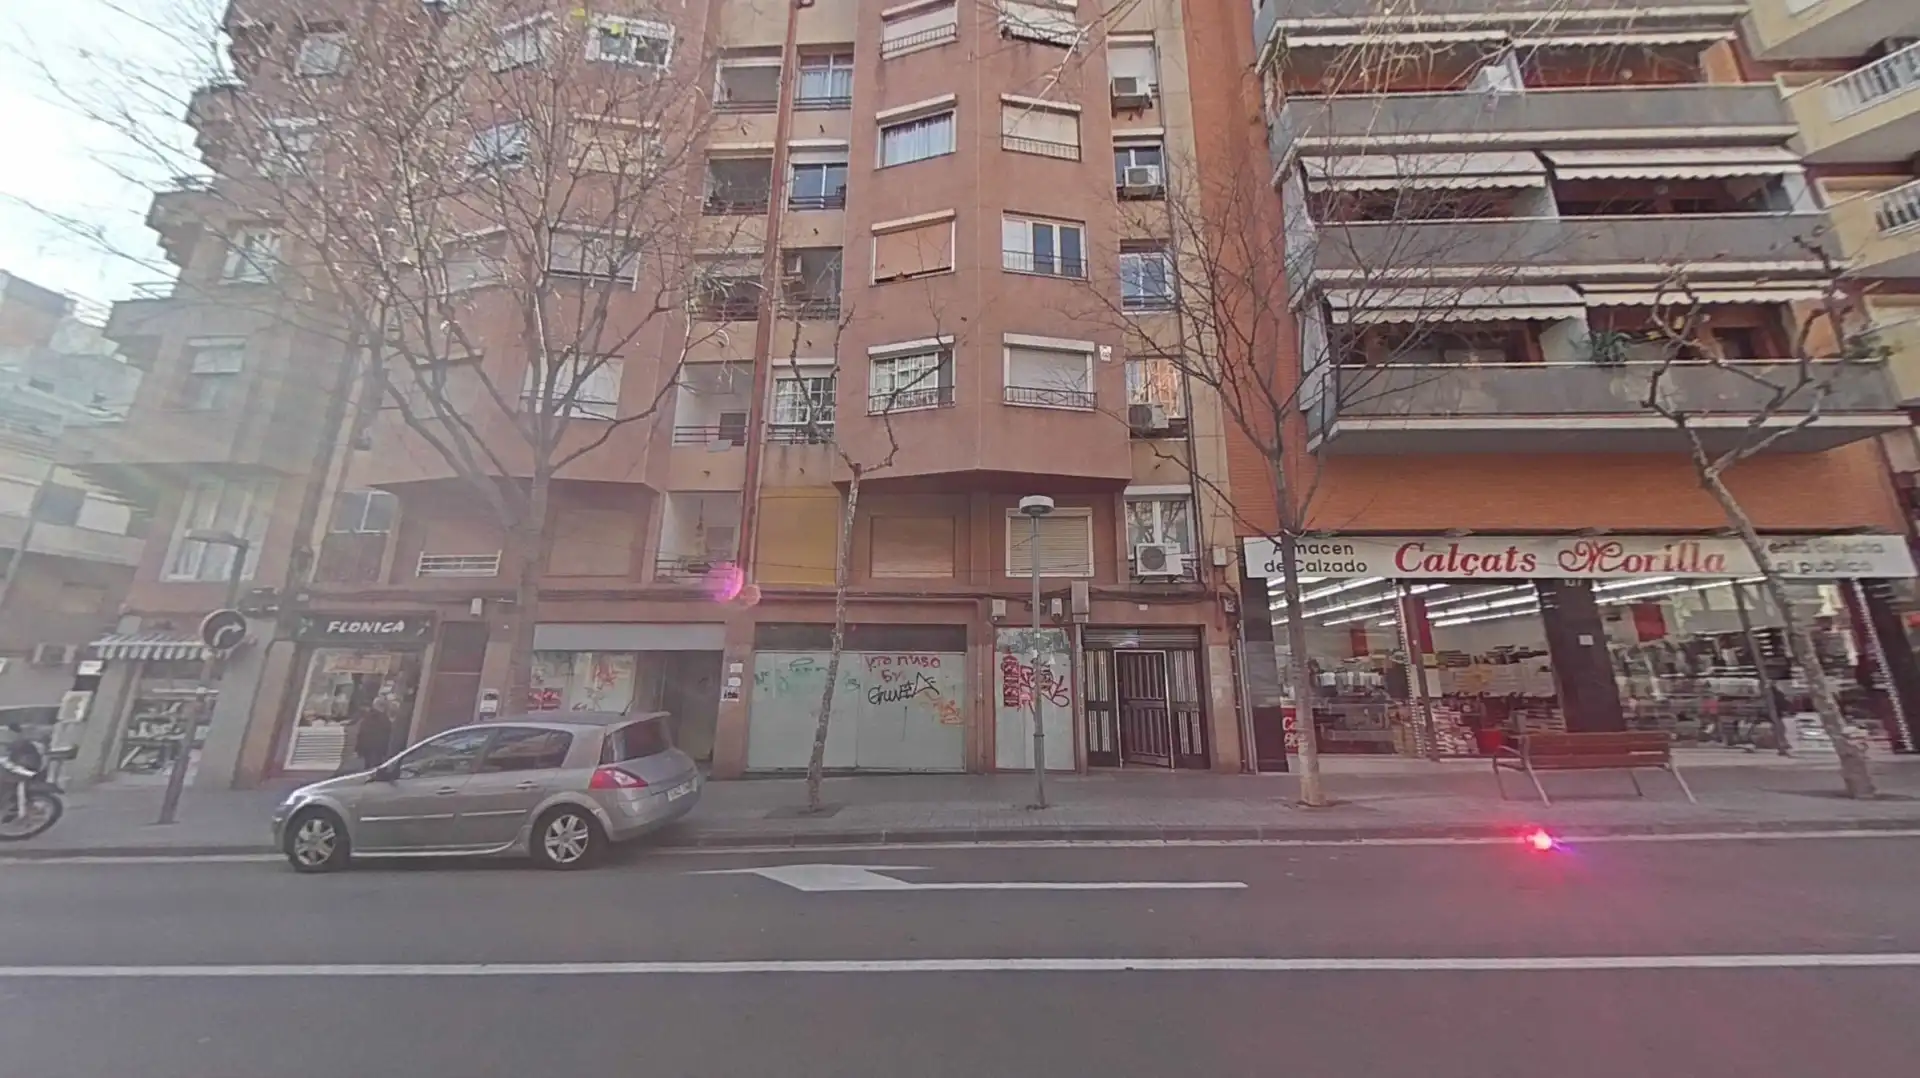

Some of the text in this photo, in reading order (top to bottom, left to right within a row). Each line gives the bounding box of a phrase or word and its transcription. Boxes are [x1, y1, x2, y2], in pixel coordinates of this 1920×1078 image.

[1272, 543, 1355, 555] Amacen
[1394, 540, 1726, 576] Calçats Morilla
[326, 620, 405, 634] FLONICA
